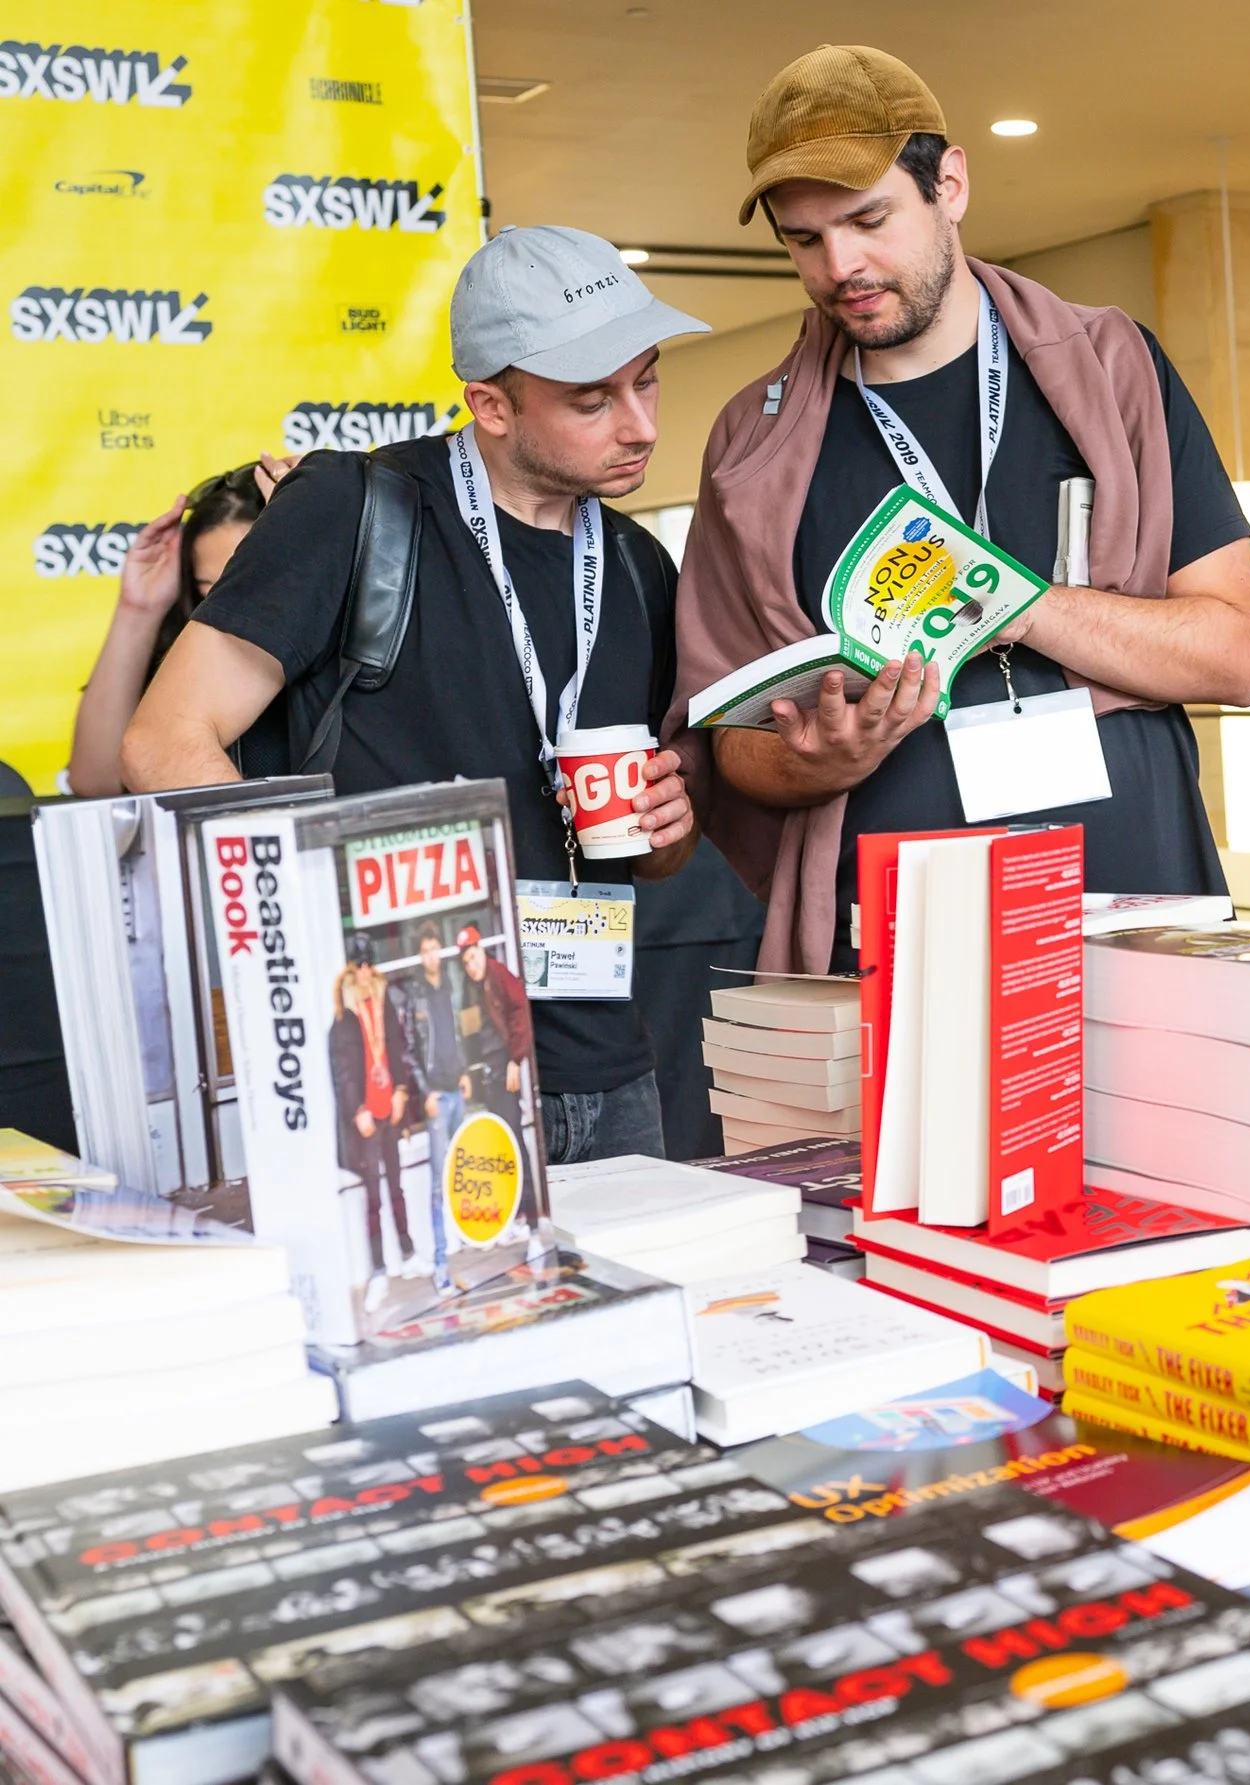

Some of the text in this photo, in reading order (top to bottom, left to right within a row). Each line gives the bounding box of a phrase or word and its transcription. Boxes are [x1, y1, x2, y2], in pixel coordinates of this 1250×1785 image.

[0, 45, 150, 107] SXSW
[264, 178, 405, 232] SXSW
[347, 308, 380, 320] BUD
[563, 272, 619, 304] bronzi
[10, 289, 168, 344] SXSW
[341, 320, 388, 333] LIGHT
[98, 409, 152, 427] Uber
[283, 406, 425, 452] SXSW
[988, 368, 1001, 443] PLATINUM
[100, 432, 155, 450] Eats
[888, 432, 919, 466] 2019
[466, 480, 479, 511] CONAN
[33, 526, 131, 577] SXS
[580, 507, 595, 550] TEAMCOCO
[583, 555, 598, 634] PLATINUM
[863, 547, 909, 606] NON
[871, 534, 945, 645] OBVIOUS
[904, 578, 923, 602] Predict
[922, 559, 945, 579] Trends
[911, 608, 927, 629] NEW
[927, 576, 959, 606] TRENDS
[959, 559, 977, 576] FOR
[927, 565, 948, 586] Future
[907, 562, 1000, 667] 2019
[947, 603, 1011, 661] ROHIT BHARGAVA
[854, 647, 870, 666] NON
[214, 836, 261, 958] Book
[354, 838, 482, 918] PIZZA
[453, 1172, 493, 1200] Boys
[455, 1147, 516, 1176] Beastie
[460, 1199, 502, 1223] Book
[1157, 1347, 1185, 1382] THE
[1188, 1358, 1236, 1401] FIXER
[1165, 1390, 1195, 1425] THE
[1200, 1401, 1250, 1445] FIXER
[79, 1474, 446, 1567] CONTACT
[464, 1434, 651, 1484] HIGH
[787, 1474, 887, 1509] UX
[824, 1443, 1097, 1523] Optimization
[488, 1581, 1195, 1785] CONTACT HIGH
